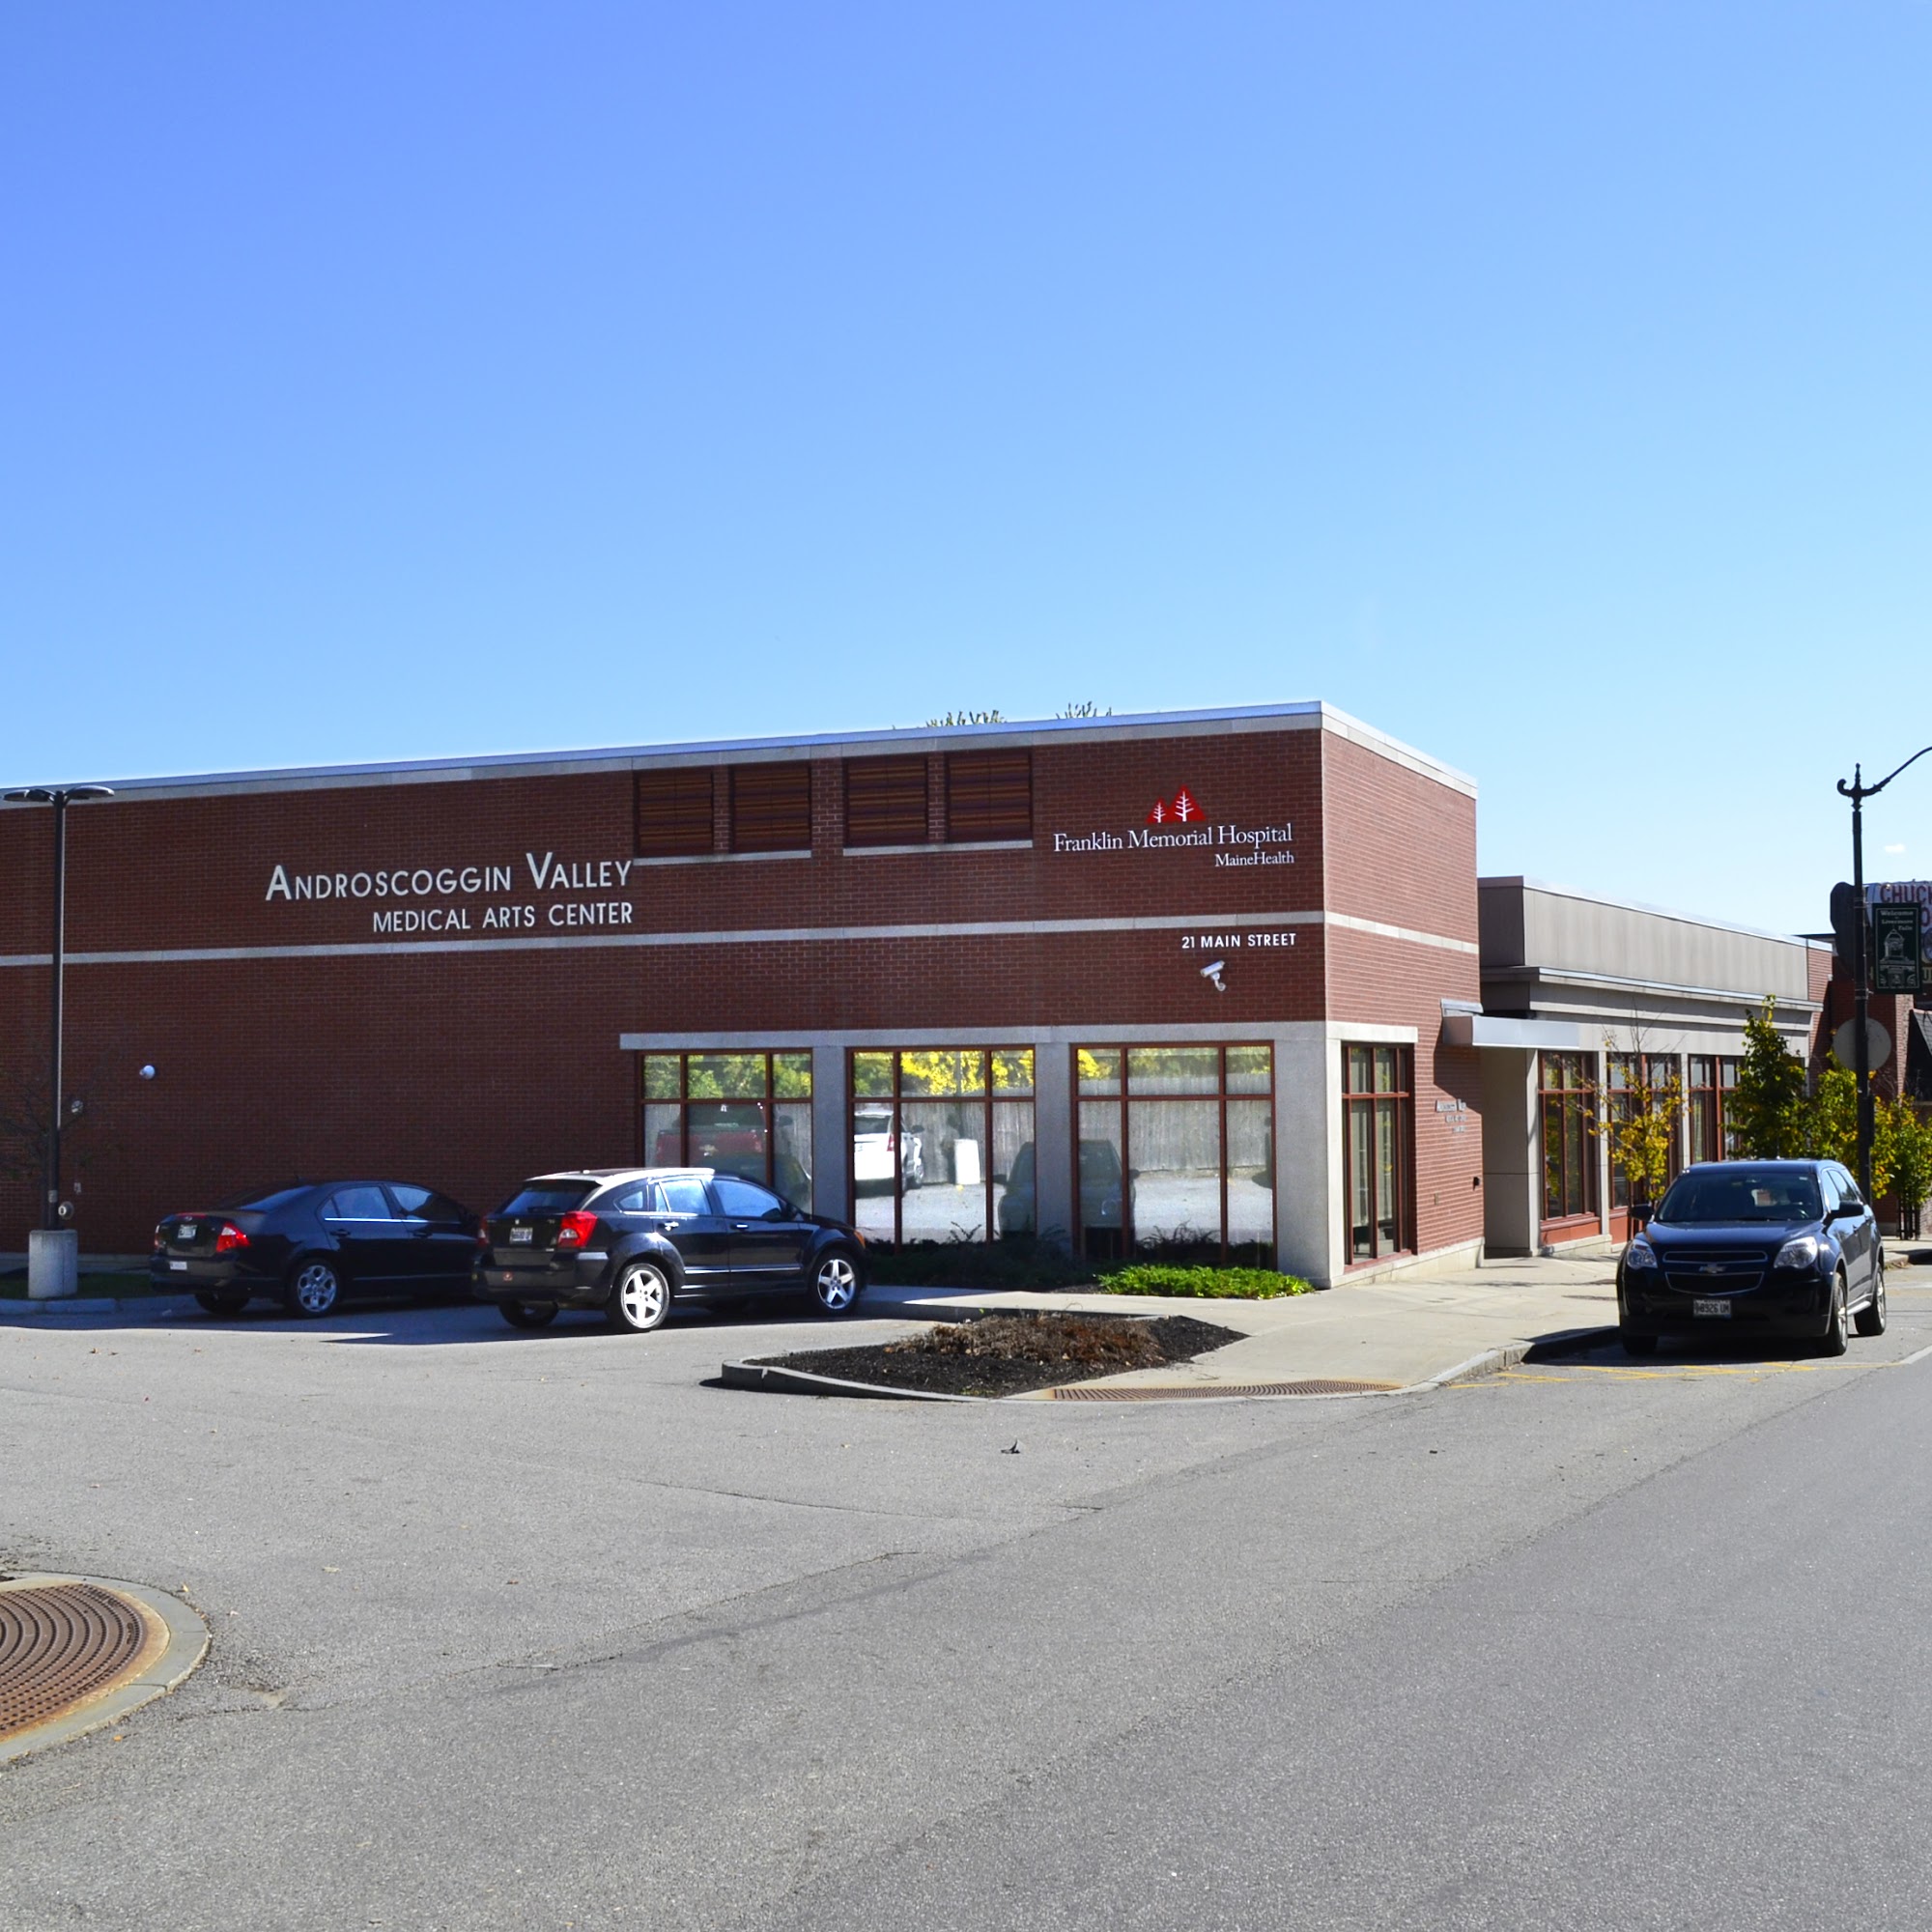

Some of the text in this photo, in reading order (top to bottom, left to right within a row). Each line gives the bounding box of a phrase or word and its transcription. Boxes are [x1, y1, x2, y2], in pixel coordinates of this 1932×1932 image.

[1053, 823, 1293, 852] Franklin Memorial Hospital
[1214, 851, 1294, 867] MaineHealth
[265, 851, 632, 901] ANDROSCOGGIN VALLEY
[373, 901, 633, 932] MEDICAL ARTS CENTER
[1181, 932, 1296, 949] 21 MAIN STREET
